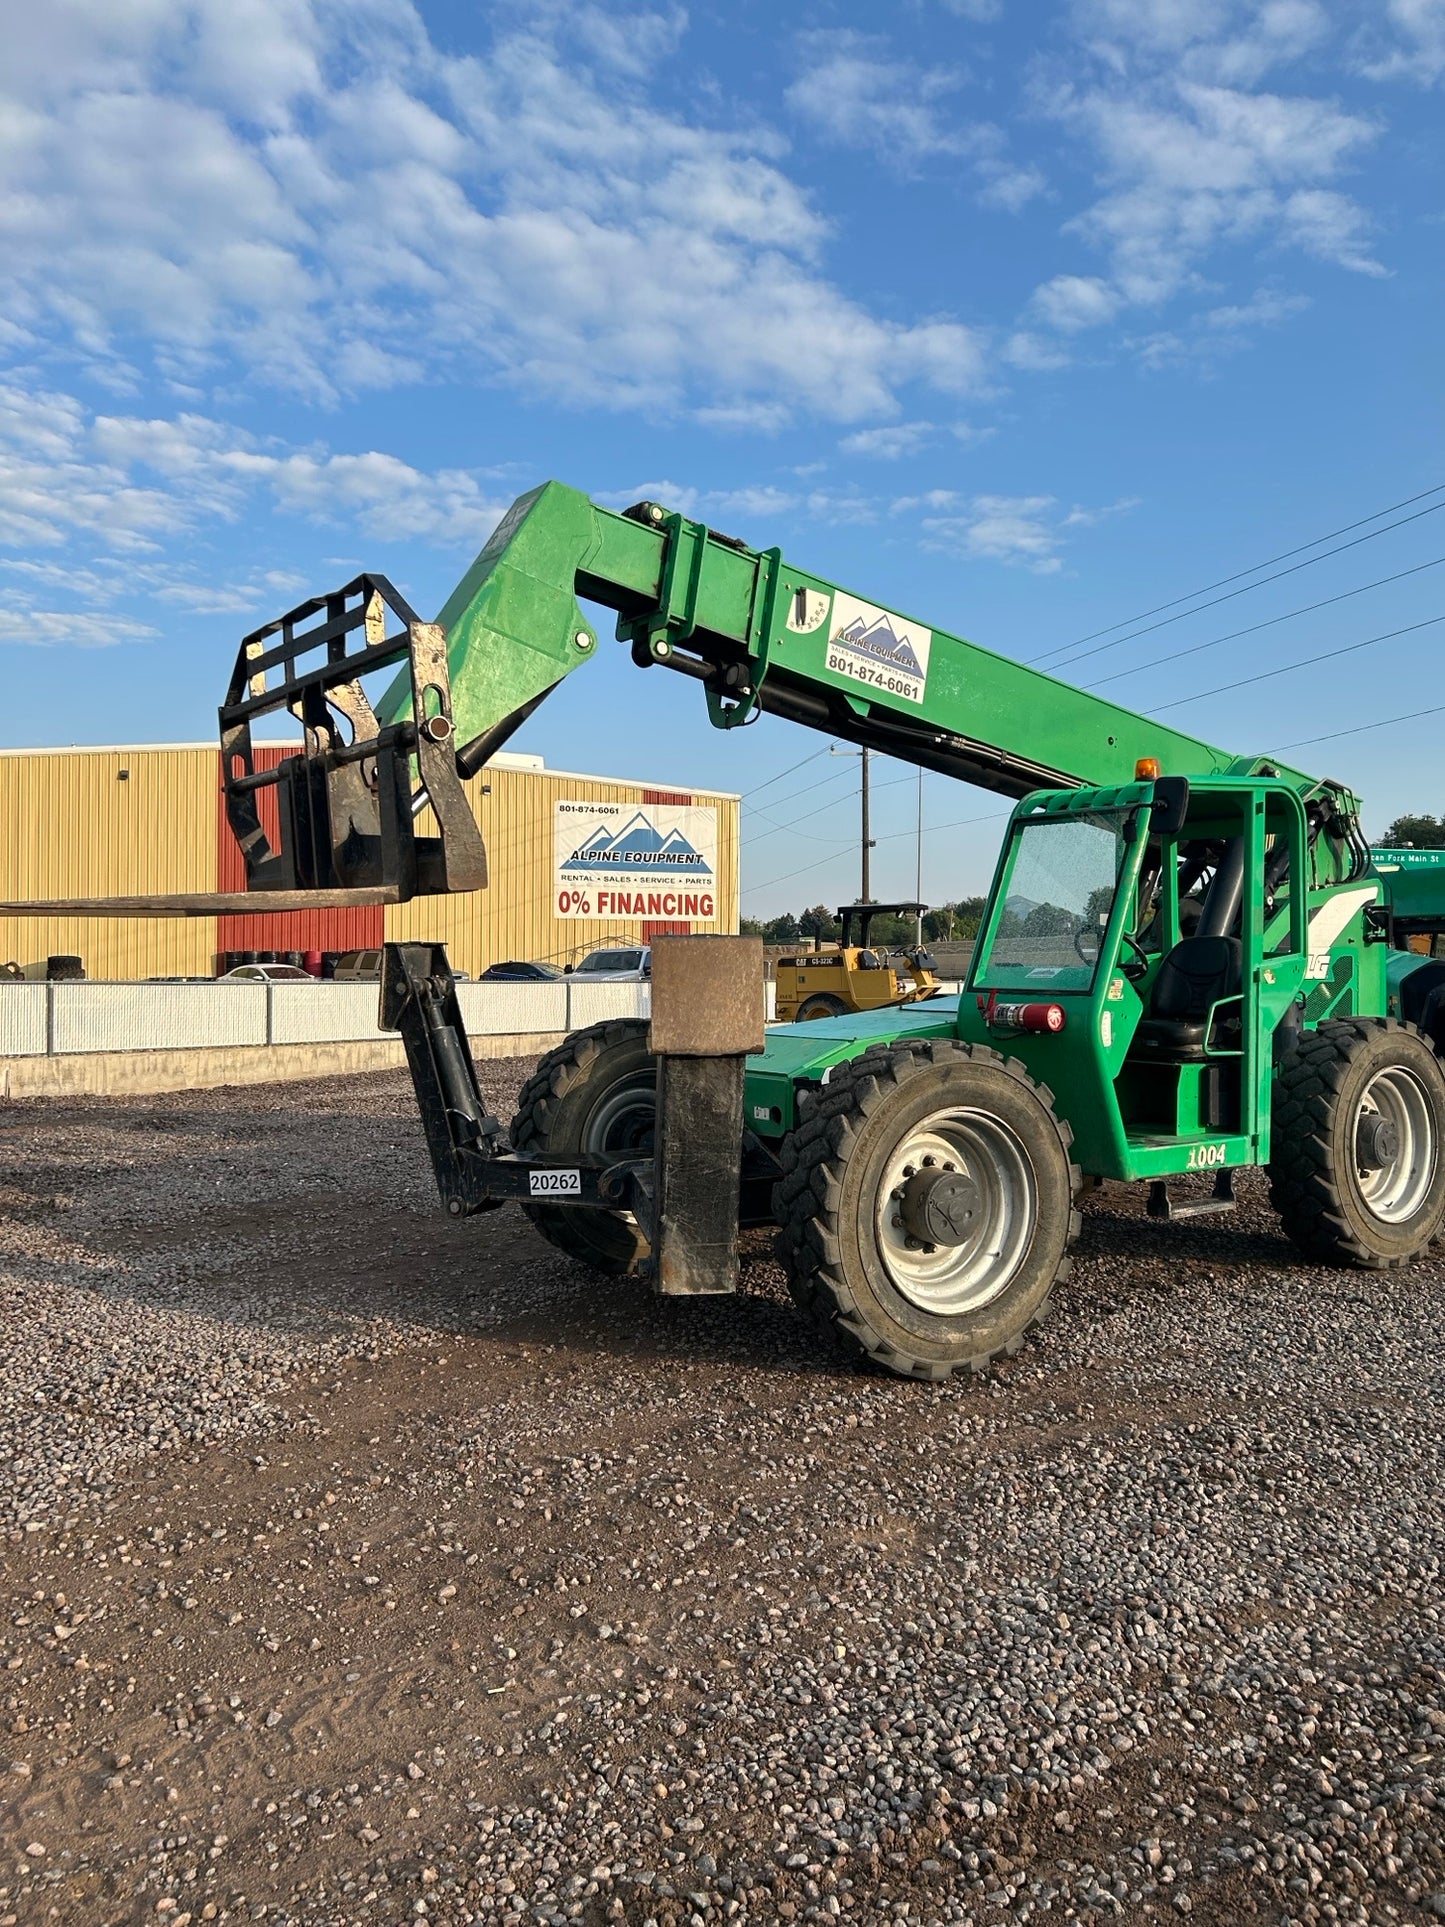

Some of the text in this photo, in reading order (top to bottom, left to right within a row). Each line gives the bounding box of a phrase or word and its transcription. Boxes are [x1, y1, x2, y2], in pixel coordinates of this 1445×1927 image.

[838, 633, 917, 668] ALPINE EQUIPMENT
[831, 645, 922, 685] SALES SERVICE PARTS RENTAL
[828, 654, 919, 700] 801-874-6061
[559, 805, 619, 814] 801-874-6061
[570, 850, 704, 864] ALPINE EQUIPMENT
[1387, 854, 1405, 862] Fork
[1408, 854, 1427, 863] Main
[1430, 855, 1439, 863] St
[560, 874, 713, 885] RENTAL SALES SERVICE PARTS
[558, 890, 714, 917] 0% FINANCING
[795, 958, 807, 967] CAT
[1186, 1143, 1226, 1169] 1004
[530, 1174, 579, 1190] 20262
